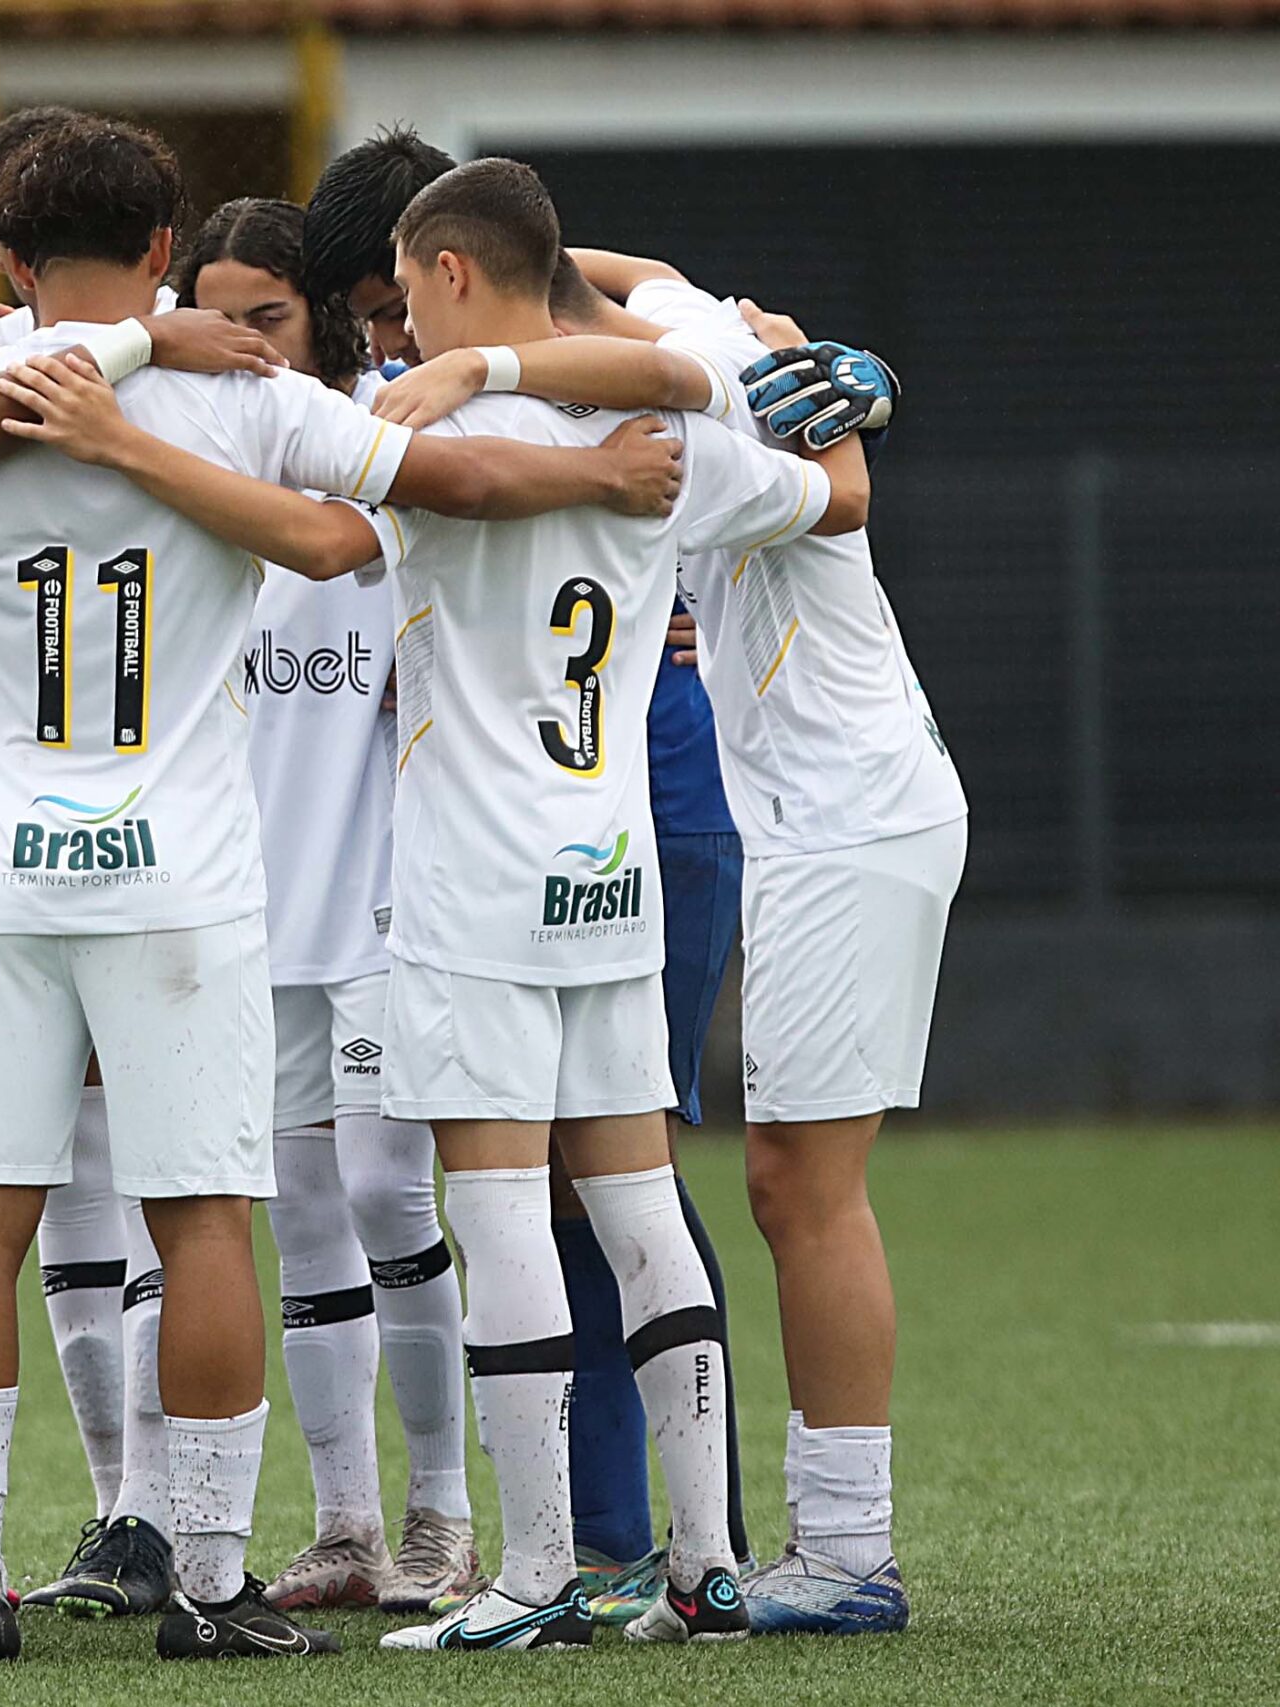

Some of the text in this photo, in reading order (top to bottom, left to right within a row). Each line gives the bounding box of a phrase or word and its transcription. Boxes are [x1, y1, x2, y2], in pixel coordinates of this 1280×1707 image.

[17, 545, 155, 755] 11
[537, 576, 619, 780] 3
[13, 819, 157, 871] Brasil
[1, 870, 171, 888] TERMINAL PORTUÁRIO
[543, 866, 642, 926] Brasil
[530, 926, 587, 943] TERMINAL
[344, 1063, 381, 1075] umbro
[695, 1354, 710, 1414] SFC
